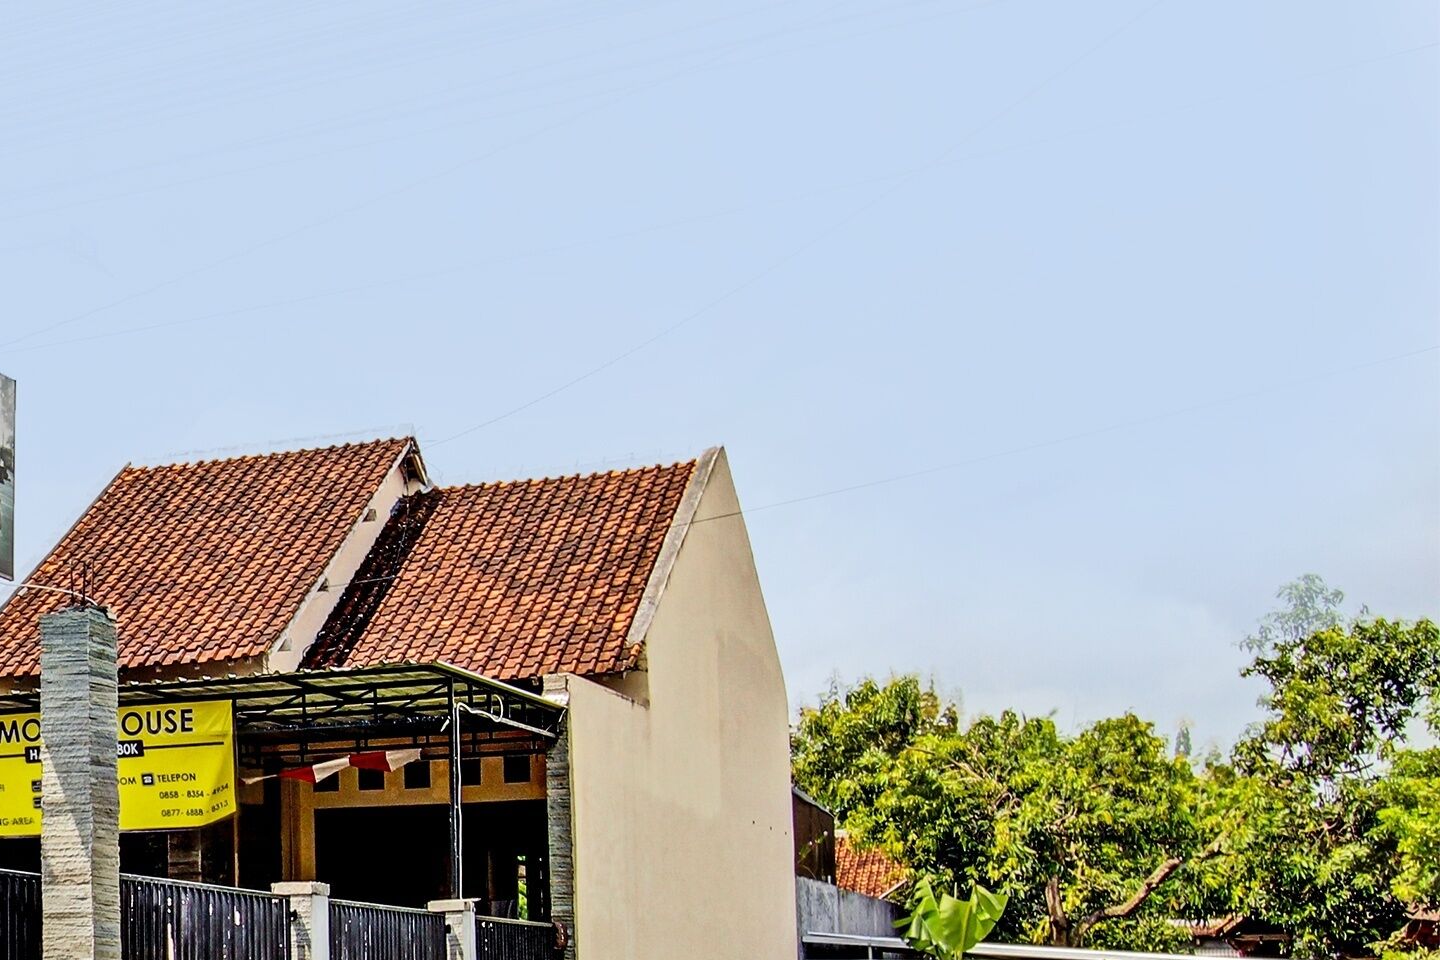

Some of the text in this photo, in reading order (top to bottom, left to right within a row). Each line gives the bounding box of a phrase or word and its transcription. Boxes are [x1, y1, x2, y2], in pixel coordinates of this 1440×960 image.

[121, 708, 194, 736] OUSE
[157, 773, 197, 783] TELEPON
[12, 817, 35, 825] AREA
